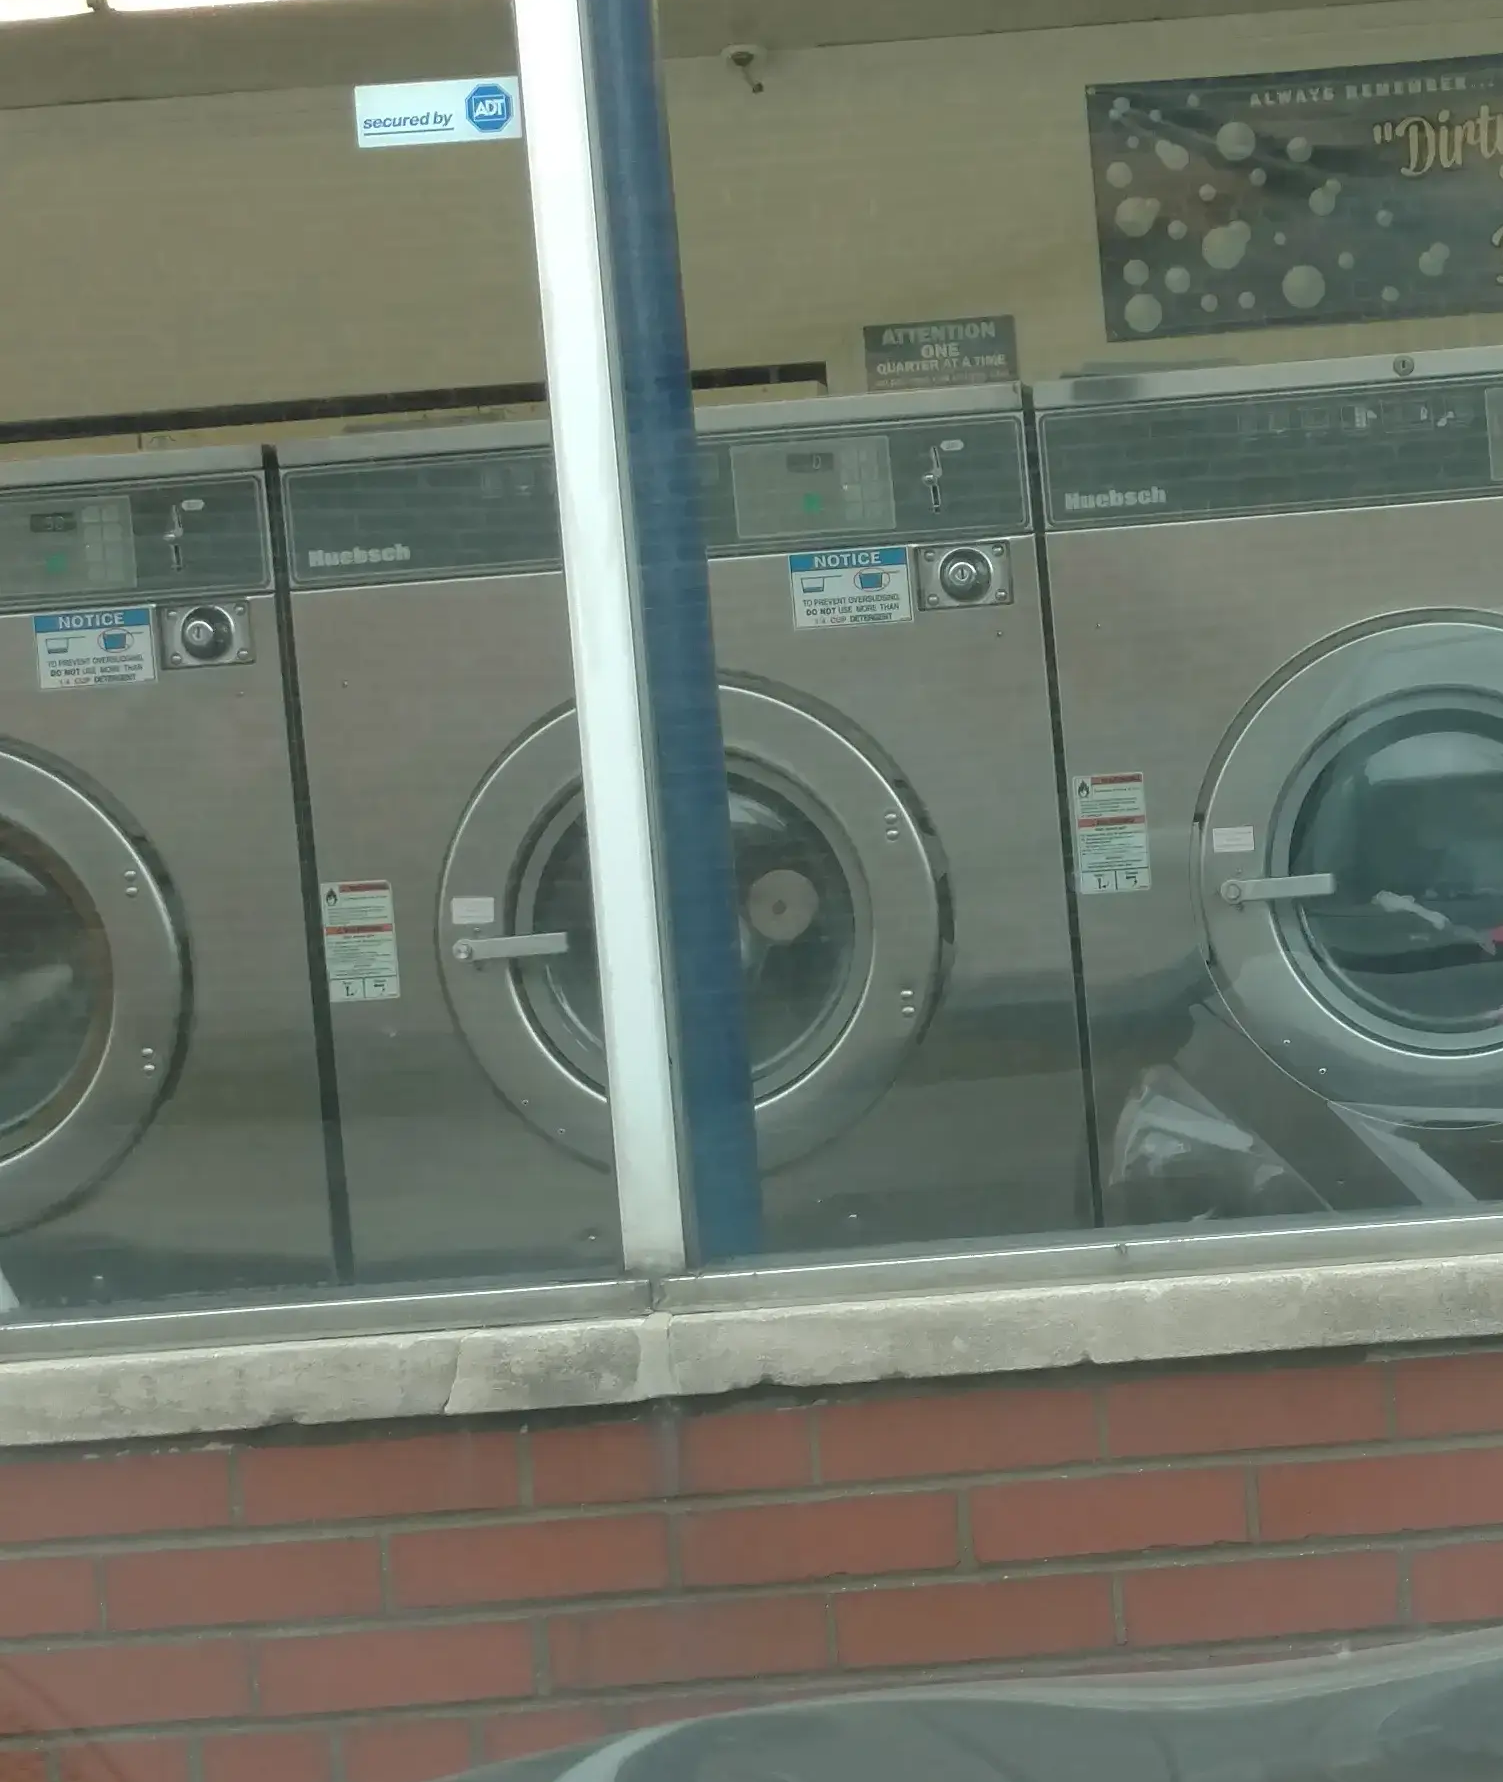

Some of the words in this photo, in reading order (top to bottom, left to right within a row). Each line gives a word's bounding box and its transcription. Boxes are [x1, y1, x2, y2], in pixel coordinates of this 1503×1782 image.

[1250, 86, 1335, 108] ALWAYS
[363, 111, 430, 130] secured
[432, 110, 453, 127] by
[474, 98, 504, 117] ADT
[881, 321, 996, 346] ATTENTION
[920, 342, 961, 359] ONE
[876, 359, 940, 376] QUARTER
[1064, 485, 1167, 510] Huebsch
[308, 543, 411, 567] Huebsch
[814, 551, 882, 568] NOTICE
[58, 612, 125, 629] NOTICE
